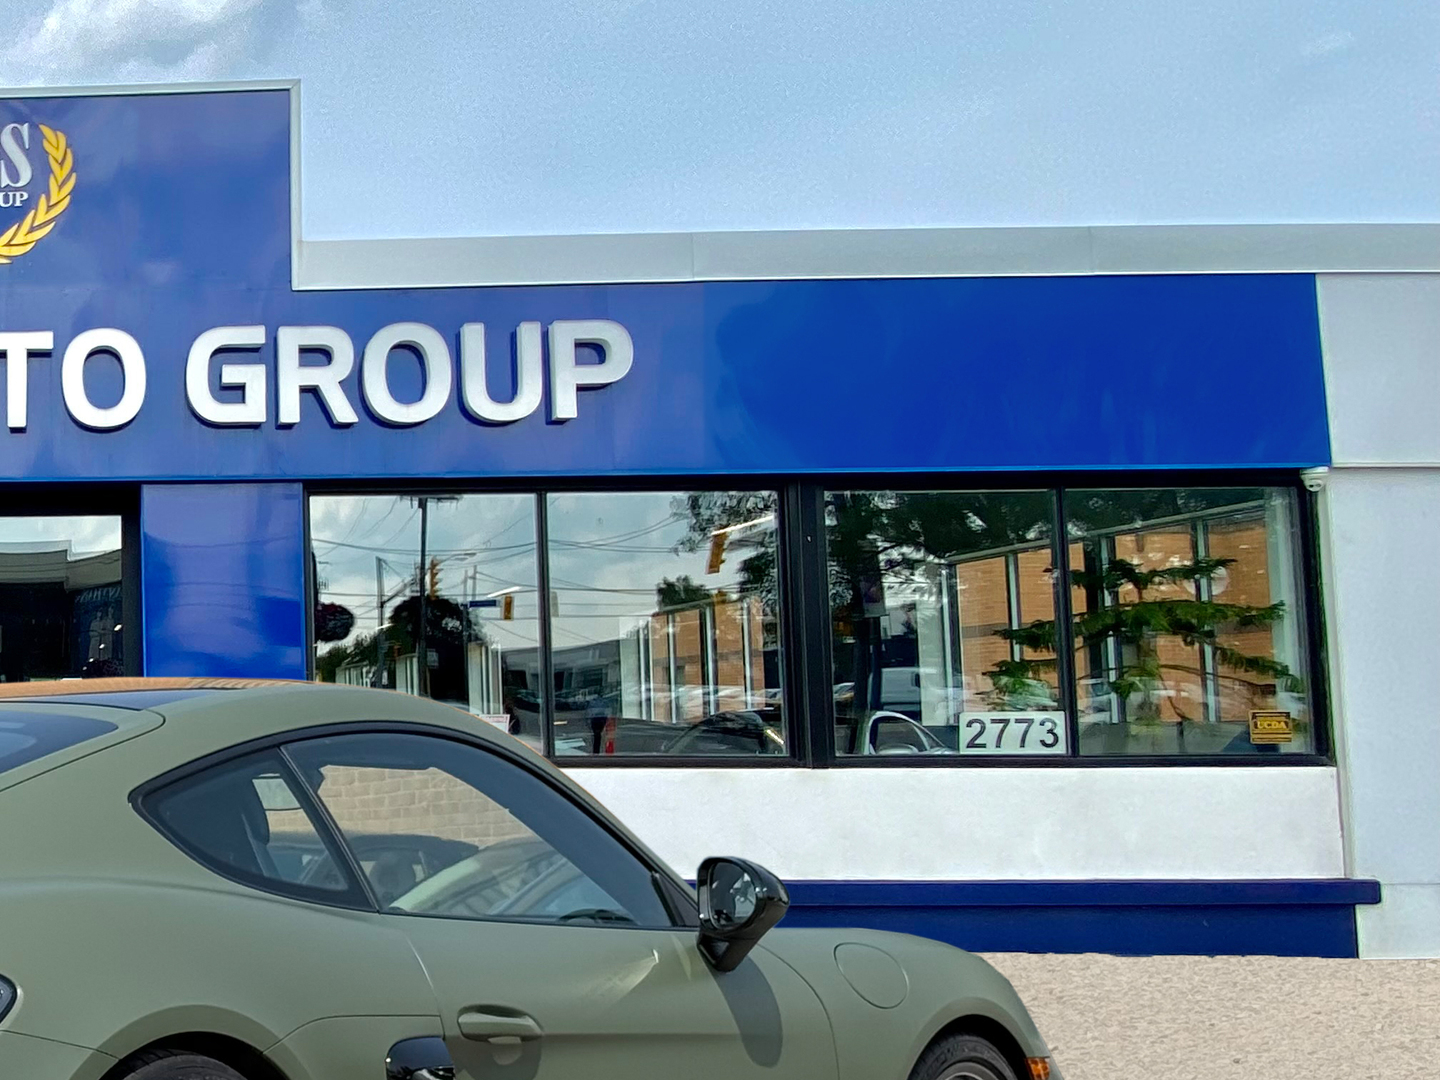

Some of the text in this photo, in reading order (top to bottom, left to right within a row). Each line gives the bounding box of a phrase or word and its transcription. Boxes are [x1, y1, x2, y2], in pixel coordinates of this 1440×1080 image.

[186, 320, 634, 430] GROUP
[964, 717, 1060, 750] 2773
[1257, 720, 1287, 729] UCDA
